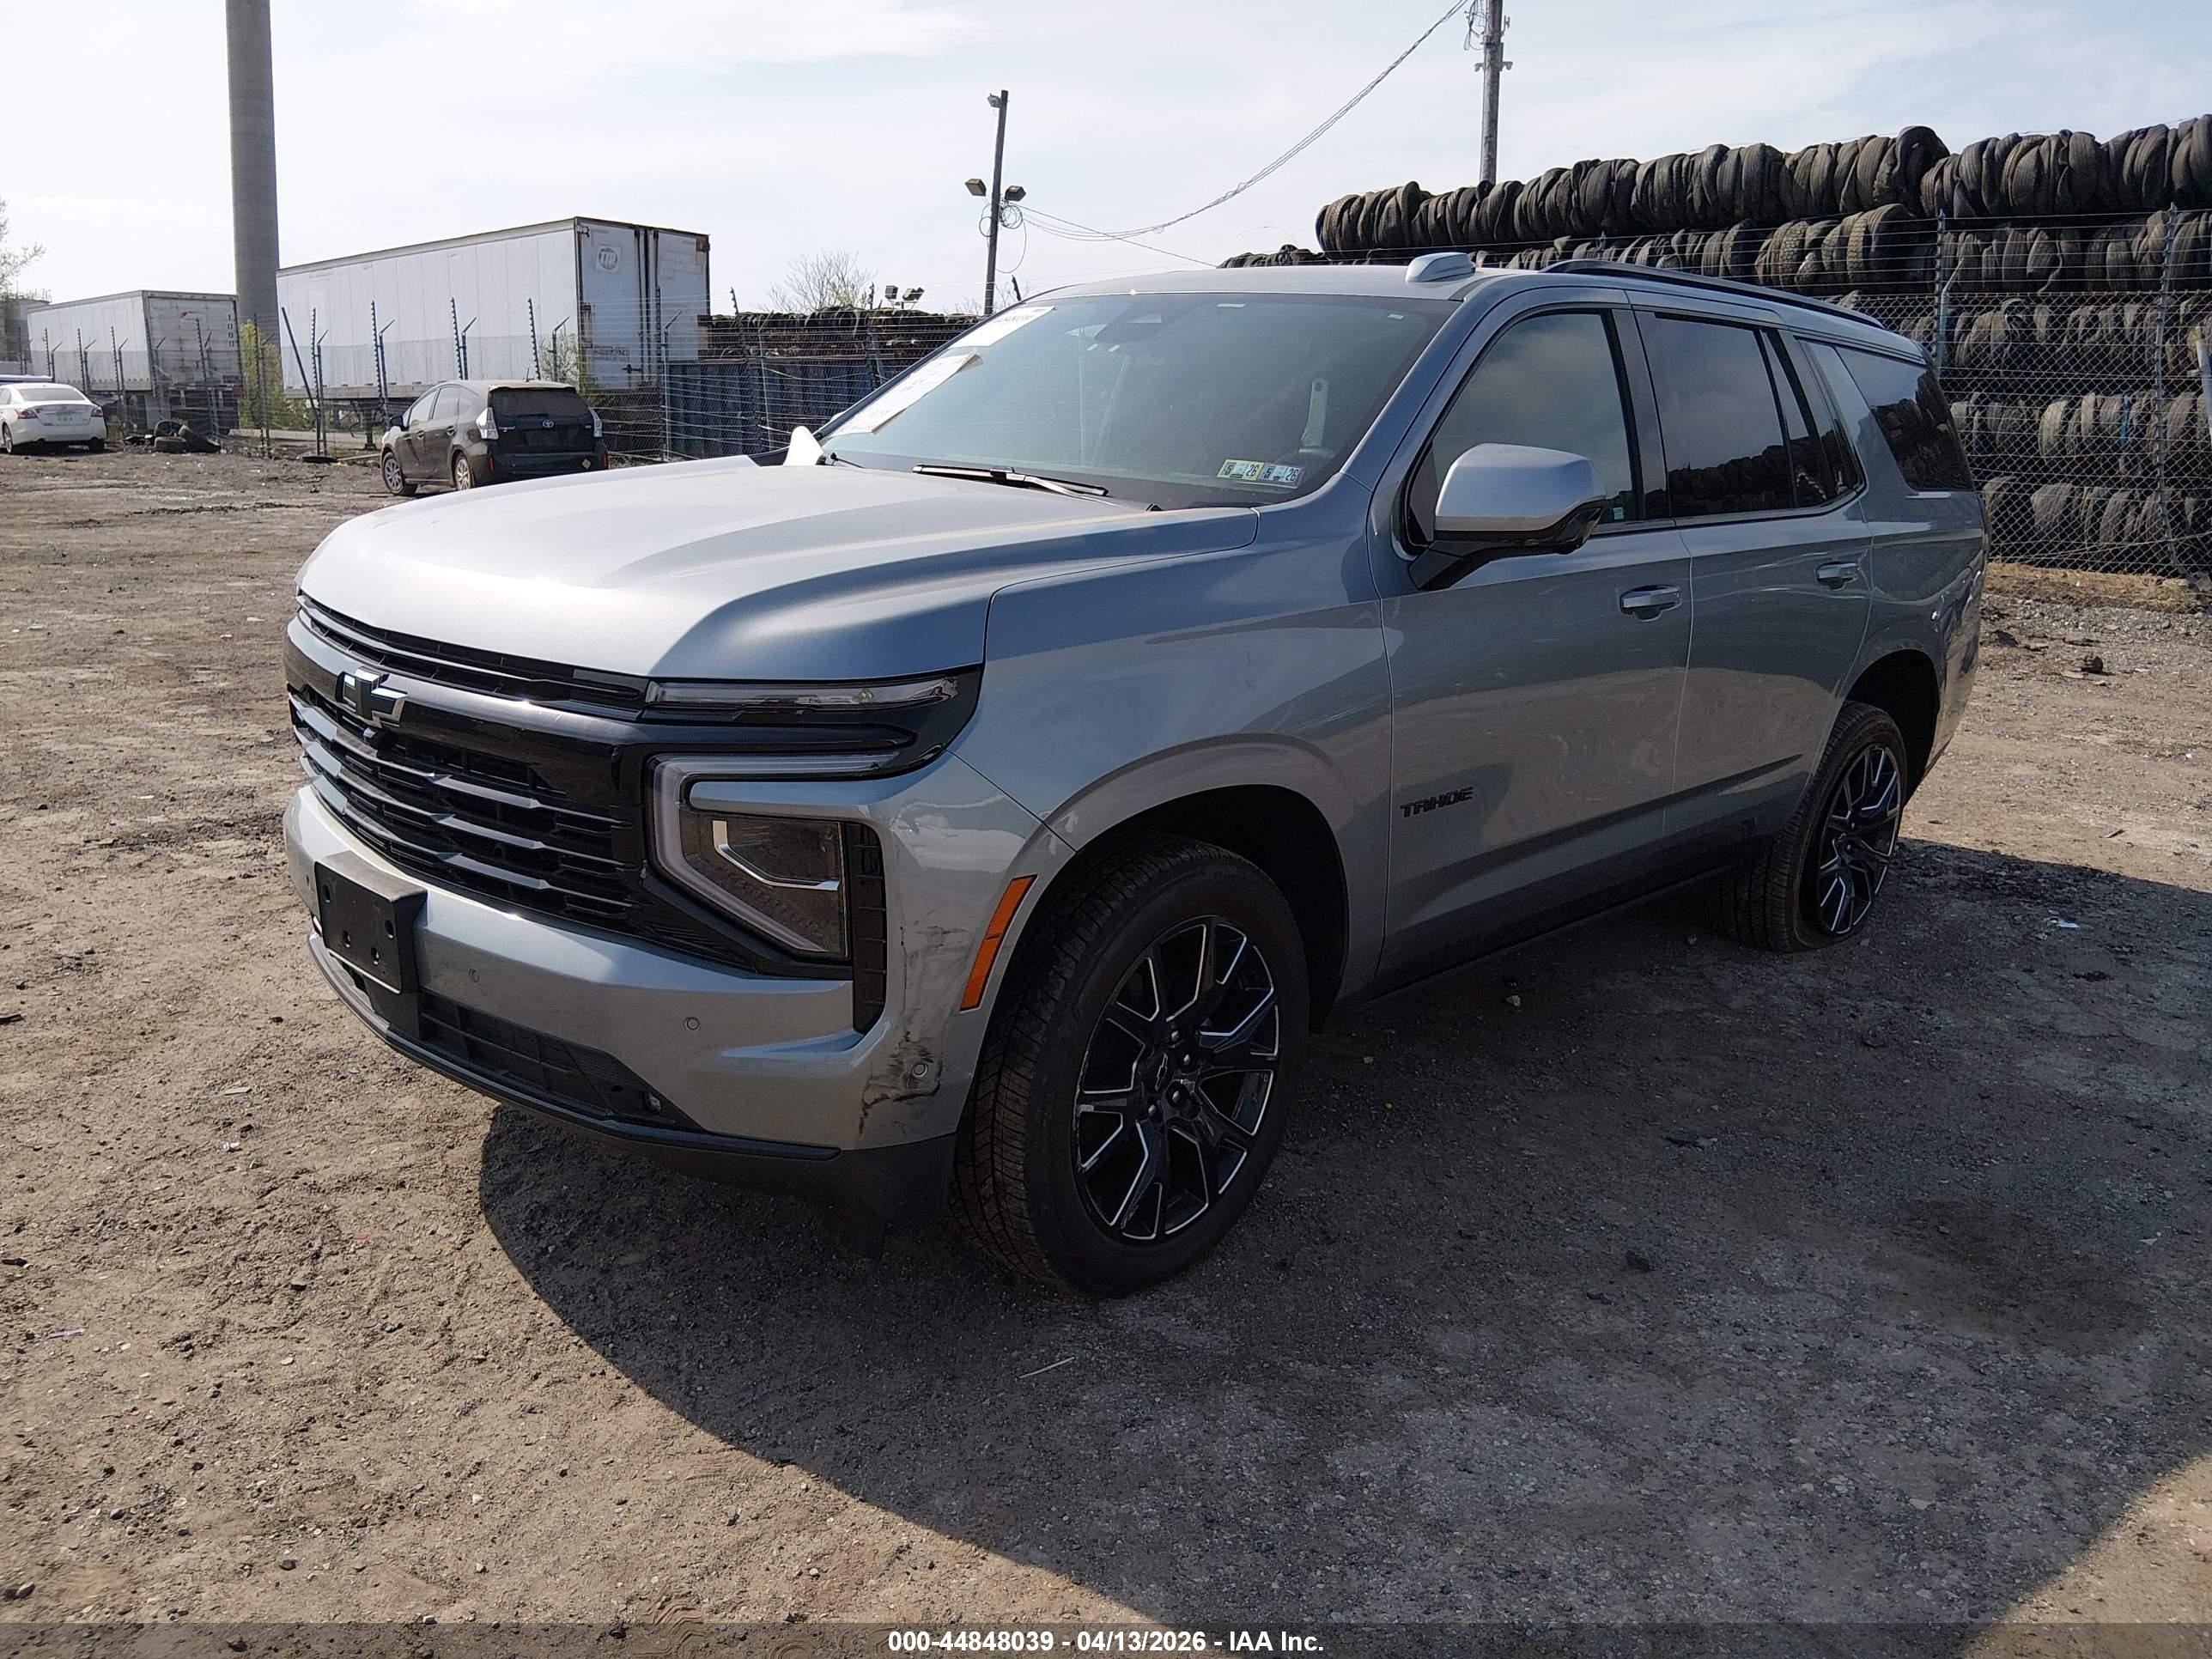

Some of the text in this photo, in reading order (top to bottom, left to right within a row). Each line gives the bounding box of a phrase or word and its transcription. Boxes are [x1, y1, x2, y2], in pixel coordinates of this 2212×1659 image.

[1245, 464, 1260, 477] 26
[1285, 468, 1299, 482] 26
[1400, 786, 1474, 818] TAHOE
